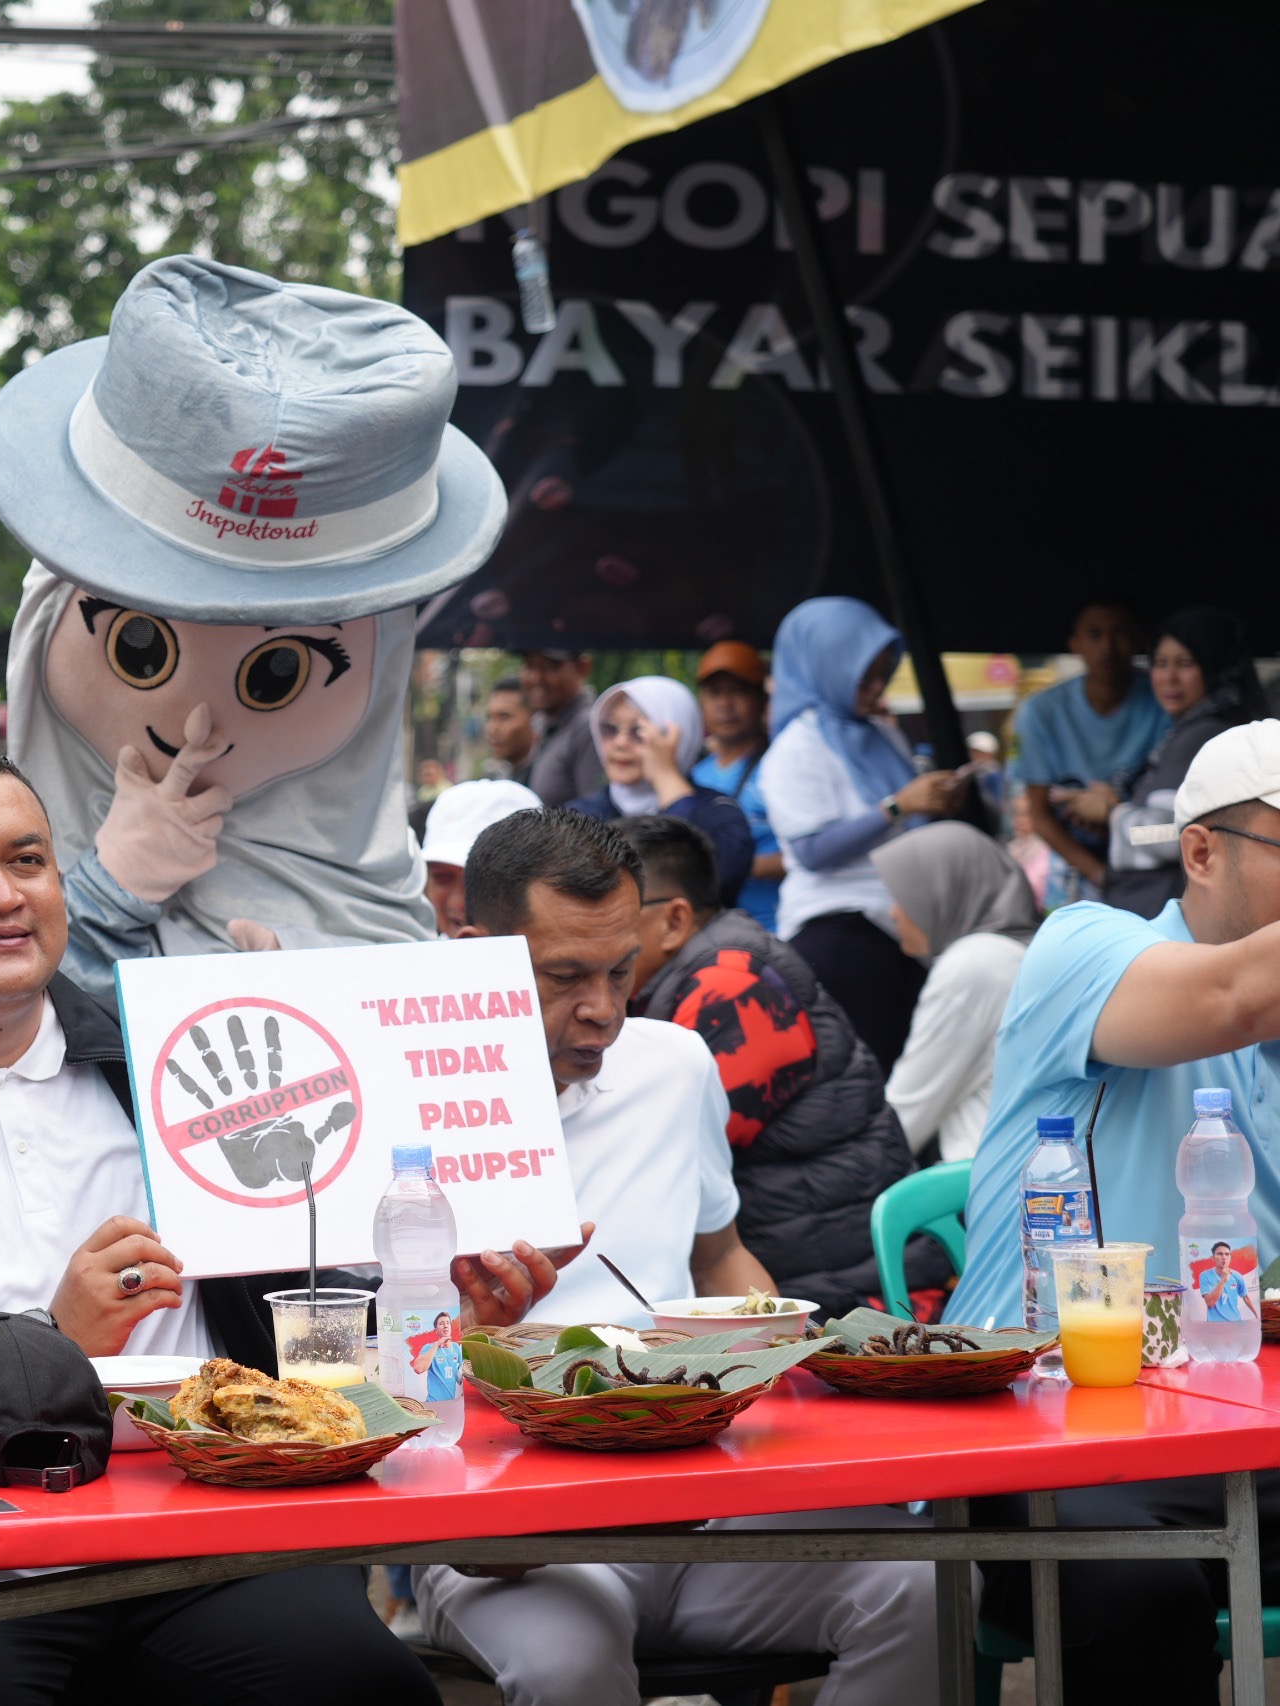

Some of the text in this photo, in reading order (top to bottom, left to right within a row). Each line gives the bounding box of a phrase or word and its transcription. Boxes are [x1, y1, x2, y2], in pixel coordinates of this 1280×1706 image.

[444, 295, 1280, 407] BAYAR SEIKL
[185, 499, 319, 540] Inspektorat
[360, 989, 533, 1027] "KATAKAN
[404, 1044, 508, 1078] TIDAK
[187, 1069, 349, 1141] CORRUPTION
[419, 1097, 513, 1131] PADA
[444, 1366, 453, 1379] 10
